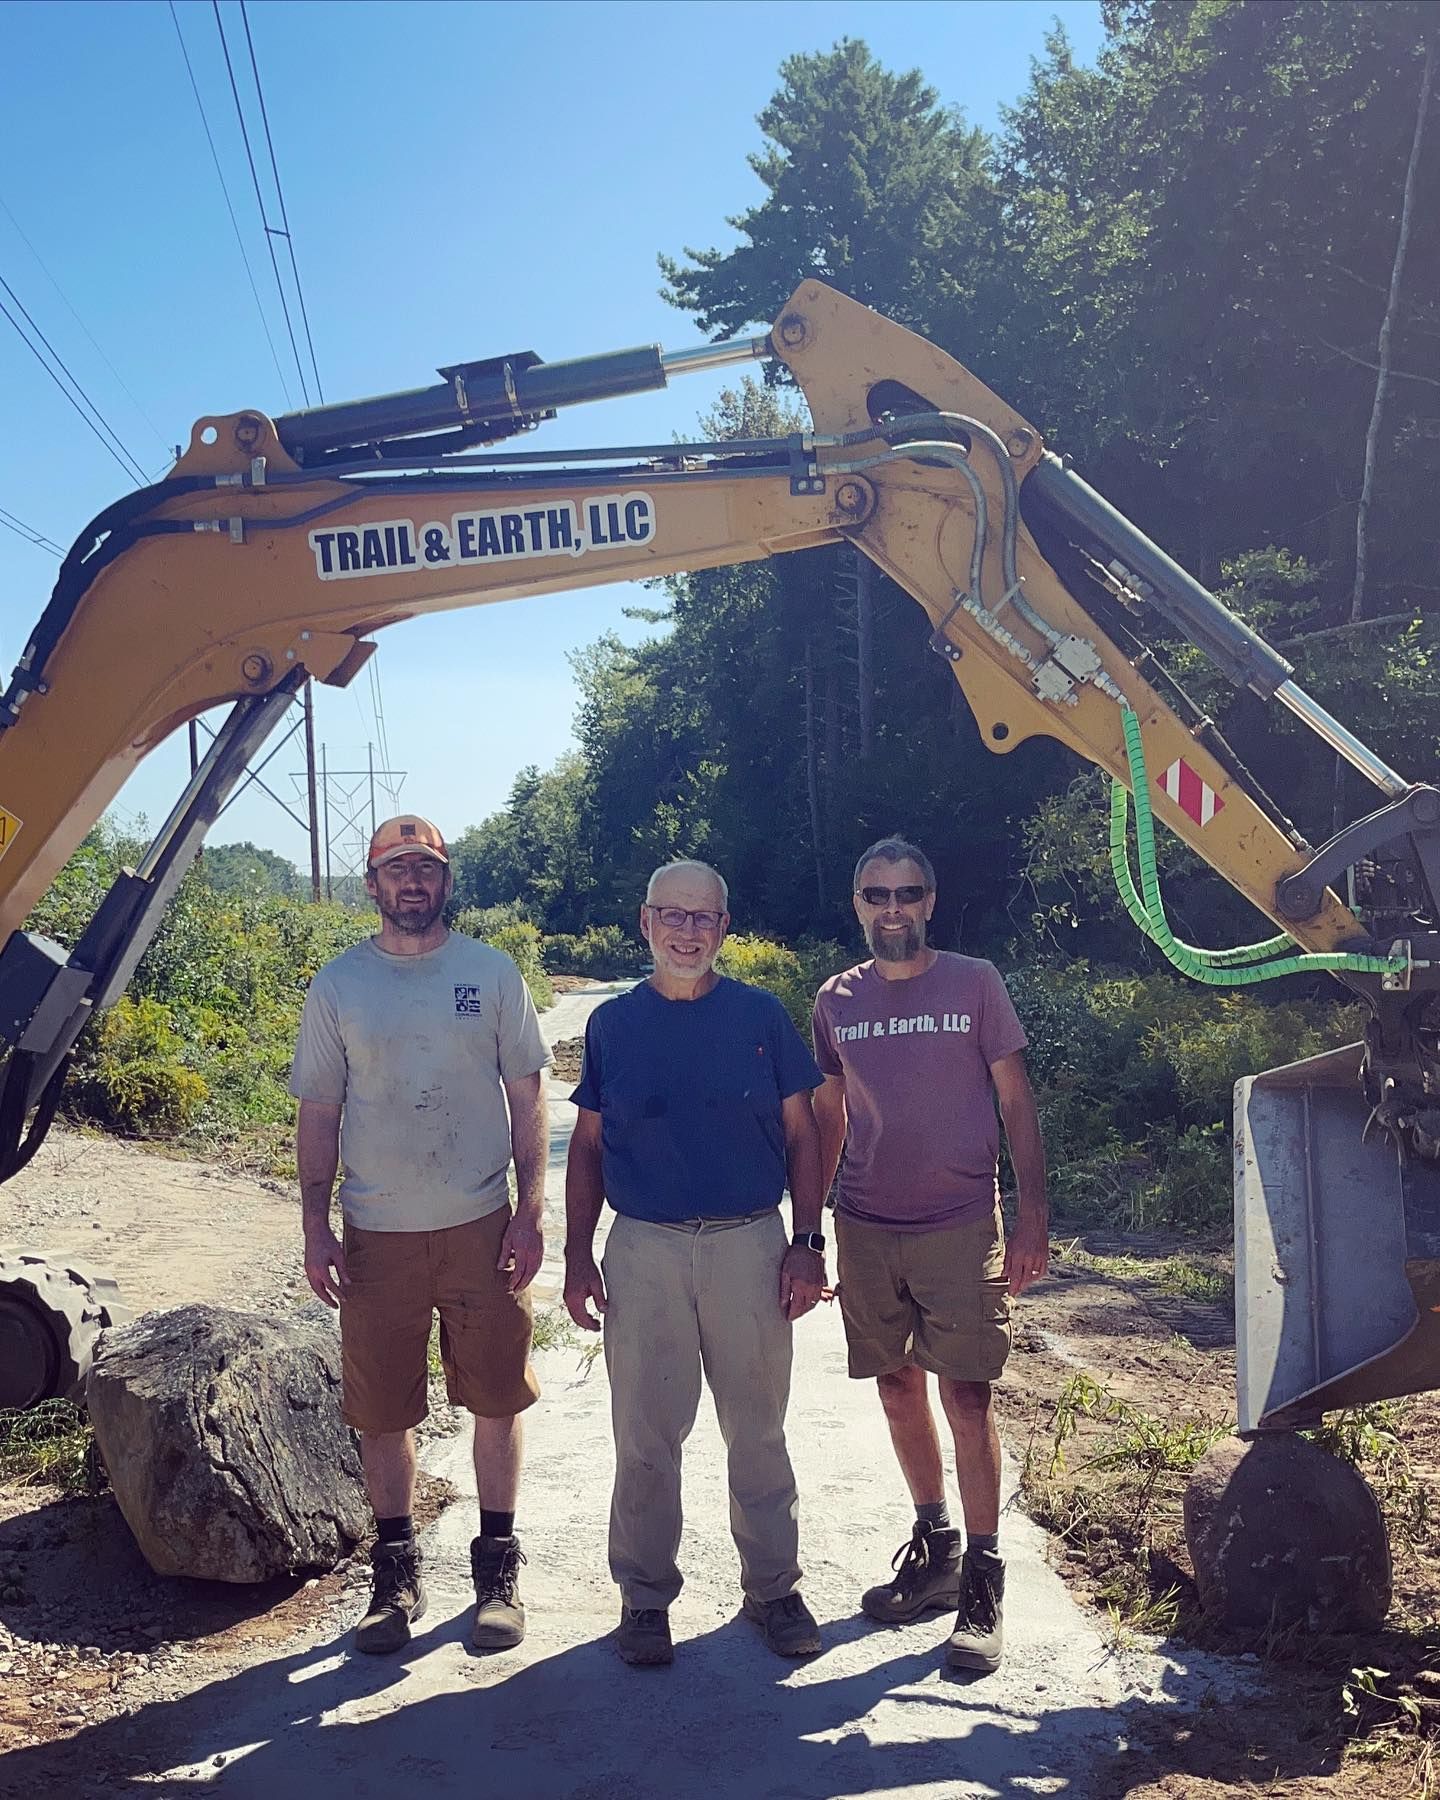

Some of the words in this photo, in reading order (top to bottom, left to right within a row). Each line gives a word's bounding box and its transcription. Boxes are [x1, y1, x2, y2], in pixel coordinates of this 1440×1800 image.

[314, 526, 416, 572] TRAIL
[424, 528, 451, 563] &
[457, 508, 583, 559] EARTH,
[589, 499, 650, 545] LLC
[834, 1021, 869, 1044] Trail
[873, 1021, 885, 1037] &
[889, 1014, 939, 1035] Earth,
[943, 1013, 971, 1034] LLC
